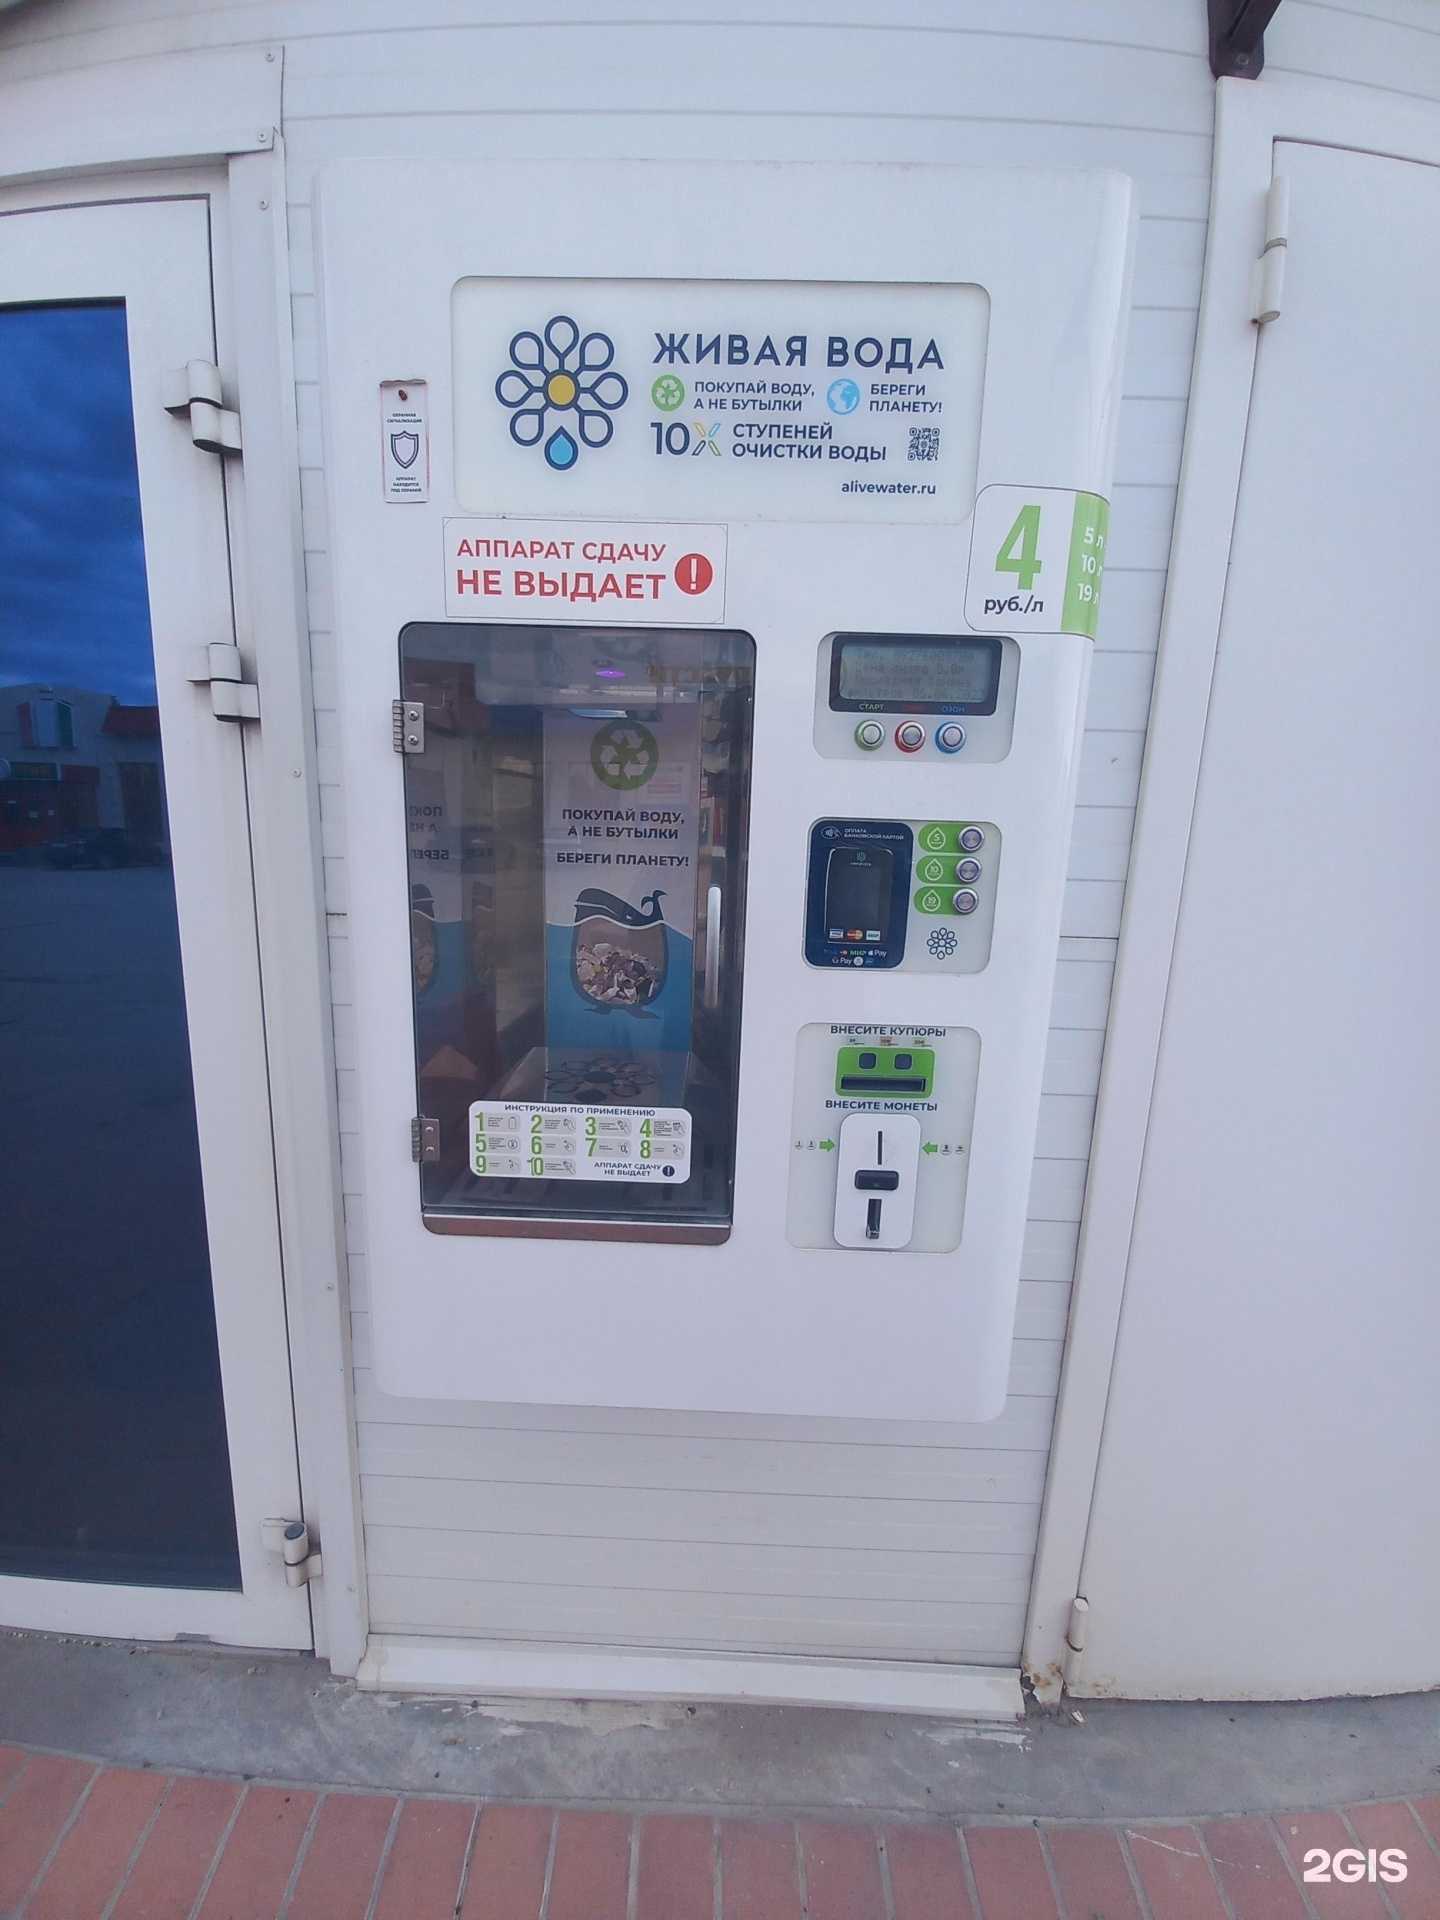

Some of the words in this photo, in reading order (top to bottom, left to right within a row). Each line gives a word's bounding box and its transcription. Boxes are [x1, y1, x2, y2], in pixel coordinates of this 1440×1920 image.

[652, 332, 807, 366] ЖИВАЯ
[827, 336, 944, 374] ВОДА
[694, 379, 766, 394] ПОКУПАЙ
[771, 383, 815, 397] ВОДУ,
[870, 383, 926, 396] БЕРЕГИ
[694, 399, 704, 410] А
[708, 399, 727, 410] НЕ
[731, 399, 802, 412] БУТЫЛКИ
[869, 400, 943, 414] ПЛАНЕТУ!
[733, 422, 833, 440] СТУПЕНЕЙ
[732, 443, 822, 460] ОЧИСТКИ
[828, 446, 887, 462] ВОДЫ
[841, 480, 936, 495] alivewater.ru
[1083, 526, 1094, 544] 5
[457, 538, 575, 560] АППАРАТ
[582, 542, 666, 564] СДАЧУ
[995, 505, 1042, 590] 4
[1081, 553, 1096, 575] 10
[457, 569, 502, 596] НЕ
[514, 571, 666, 603] ВЫДАЕТ
[1077, 583, 1092, 603] 19
[983, 594, 1044, 615] руб./л
[562, 808, 635, 821] ПОКУПАЙ
[640, 811, 685, 825] ВОДУ,
[567, 825, 578, 837] А
[582, 826, 602, 838] НЕ
[606, 827, 679, 840] БУТЫЛКИ
[557, 852, 611, 865] БЕРЕГИ
[615, 854, 689, 867] ПЛАНЕТУ!
[830, 1025, 887, 1036] ВНЕСИТЕ
[890, 1027, 946, 1037] КУПЮРЫ
[505, 1104, 567, 1113] ИНСТРУКЦИЯ
[570, 1106, 584, 1114] ПО
[586, 1107, 656, 1117] ПРИМЕНЕНИЮ
[825, 1100, 880, 1110] ВНЕСИТЕ
[884, 1102, 938, 1112] МОНЕТЫ
[475, 1112, 484, 1132] 1
[531, 1114, 542, 1134] 2
[585, 1116, 596, 1136] 3
[640, 1118, 651, 1138] 4
[476, 1133, 487, 1153] 5
[531, 1135, 542, 1155] 6
[585, 1137, 597, 1157] 7
[640, 1139, 651, 1159] 8
[476, 1155, 487, 1174] 9
[527, 1157, 544, 1176] 10
